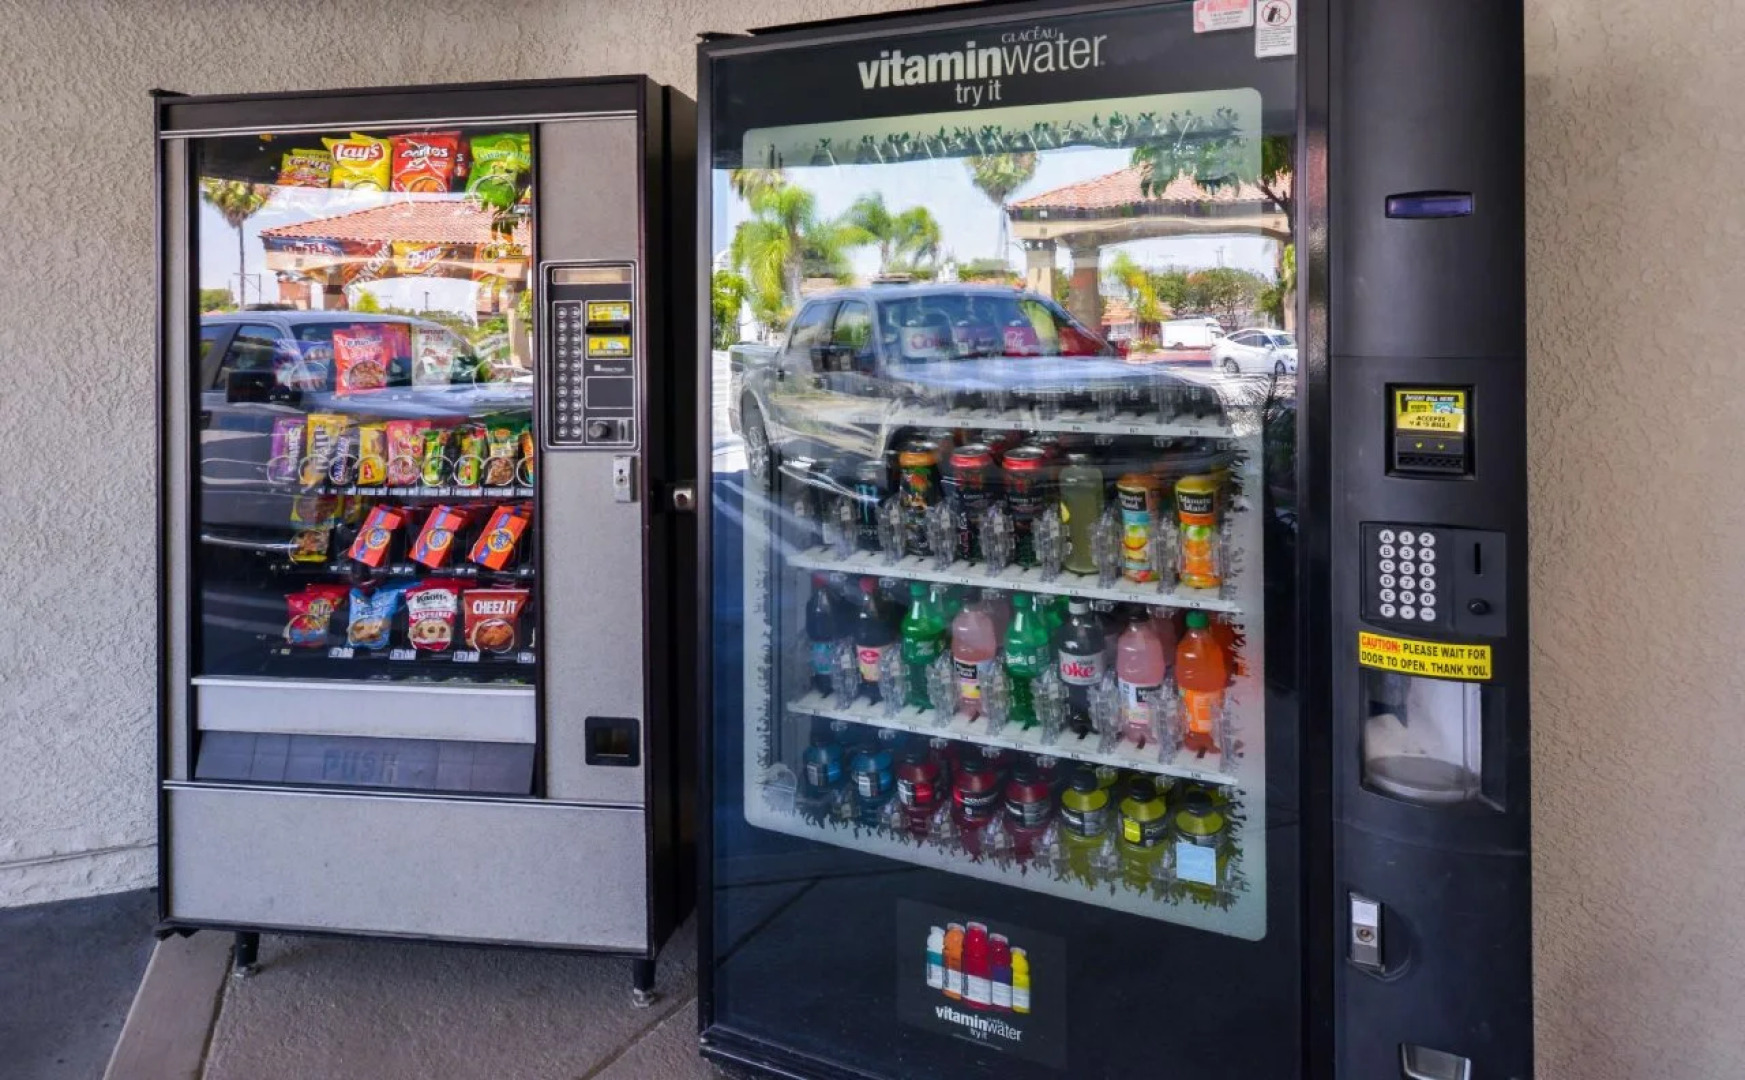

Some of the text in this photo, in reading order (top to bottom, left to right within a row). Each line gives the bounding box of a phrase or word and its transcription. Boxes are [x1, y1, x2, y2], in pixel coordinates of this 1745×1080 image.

[858, 32, 1108, 90] vitaminwater
[954, 78, 1002, 107] try it
[1361, 636, 1487, 660] CAUTION: PLEASE WAIT FOR
[1361, 651, 1384, 665] DOOR
[1387, 655, 1398, 667] TO
[1431, 662, 1464, 676] THANK
[322, 749, 399, 784] PUSH
